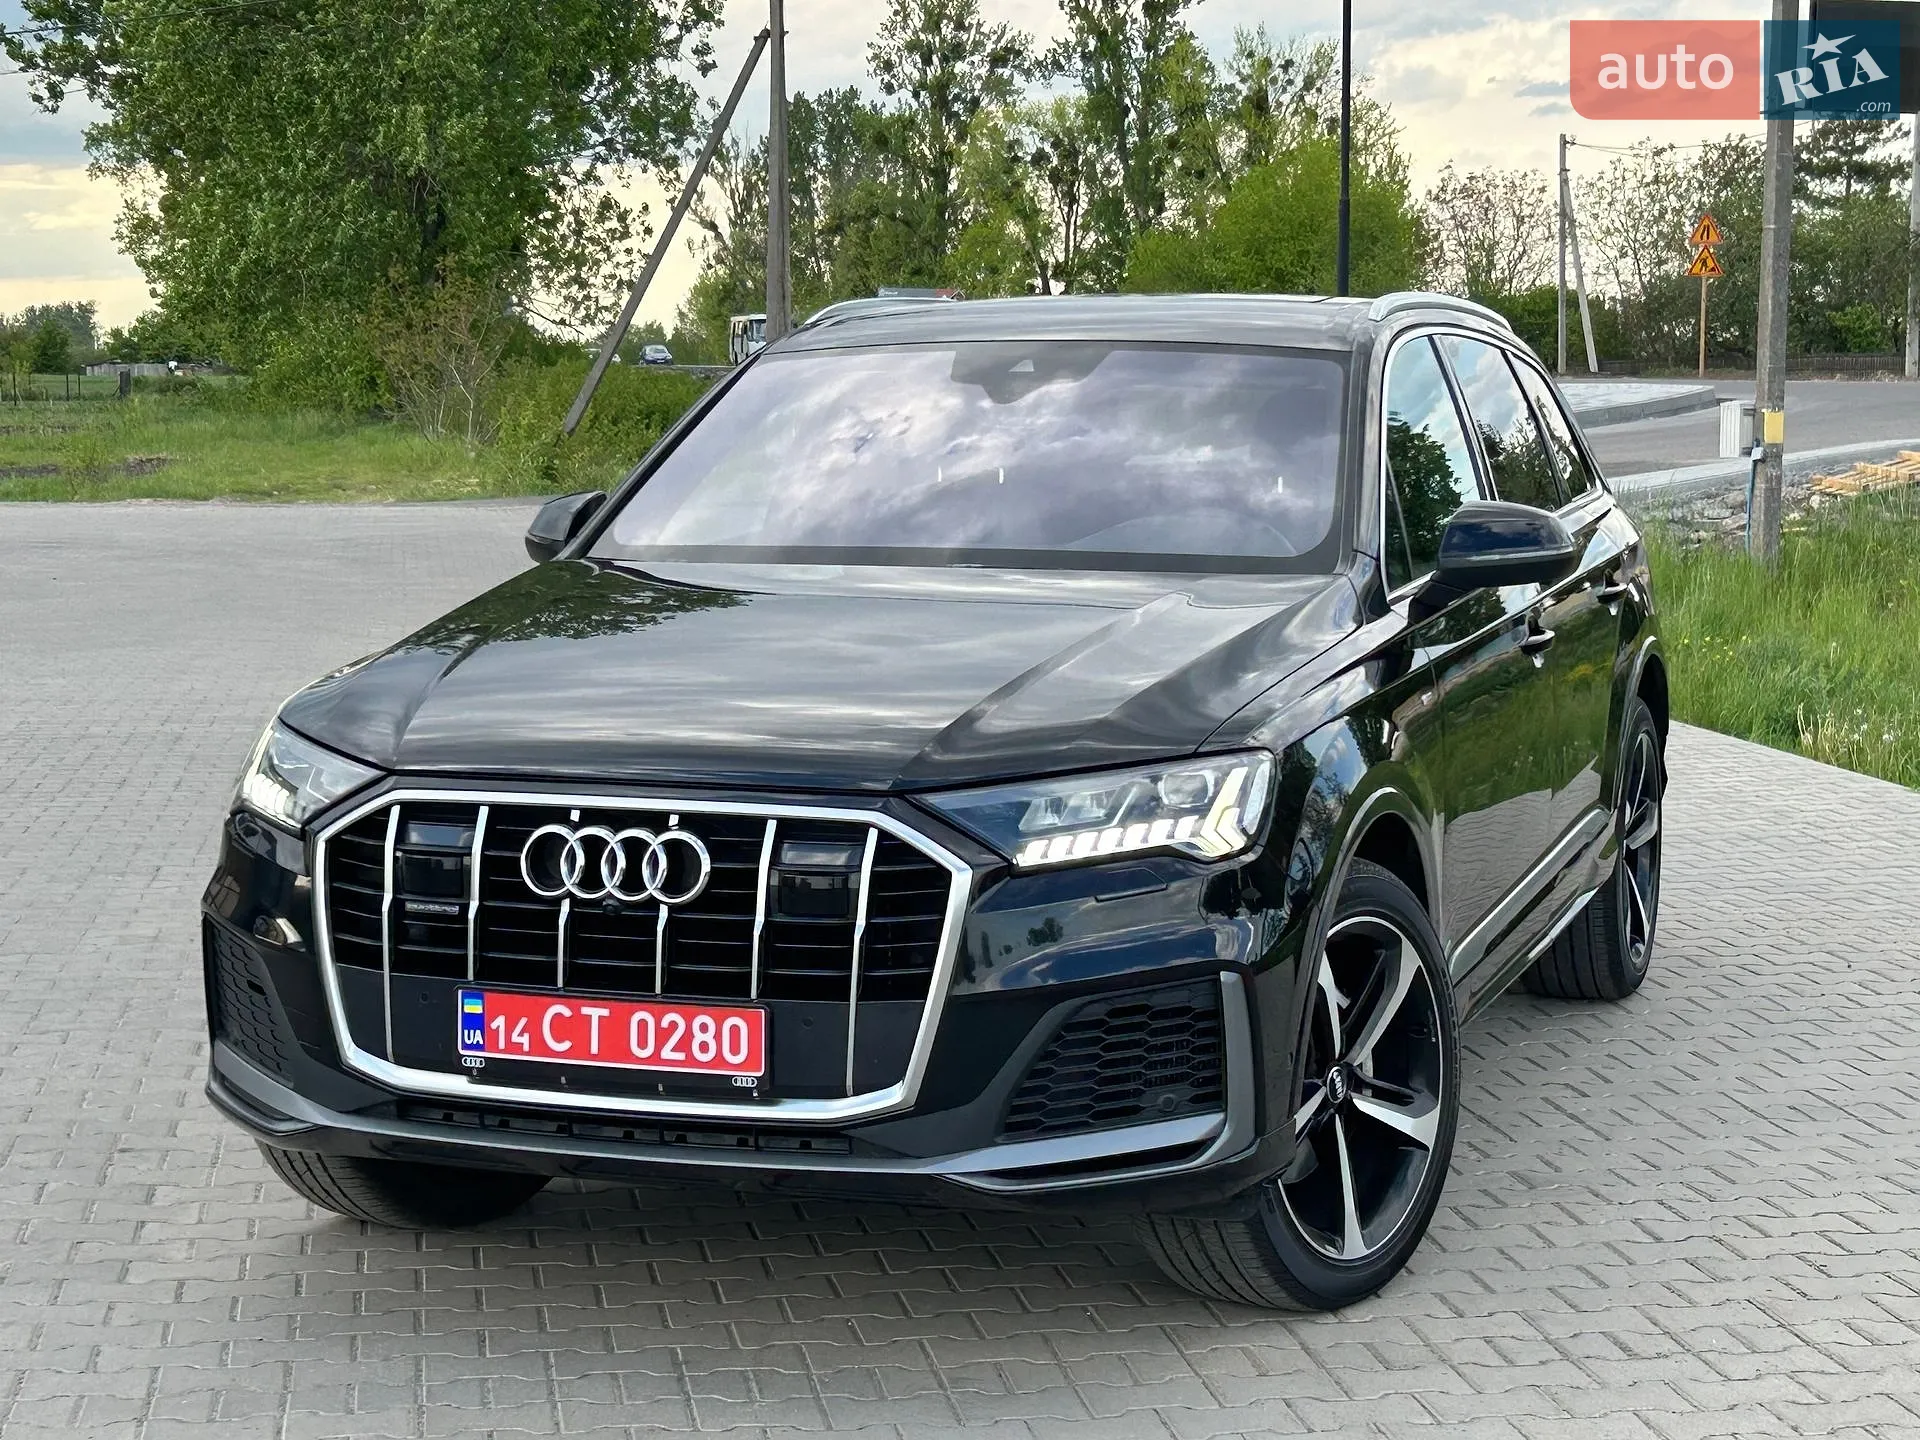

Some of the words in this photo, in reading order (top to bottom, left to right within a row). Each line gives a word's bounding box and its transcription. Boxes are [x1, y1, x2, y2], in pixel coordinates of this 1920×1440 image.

[463, 1029, 484, 1045] UA
[490, 1015, 529, 1052] 14
[542, 1004, 610, 1055] CT
[629, 1010, 749, 1065] 0280
